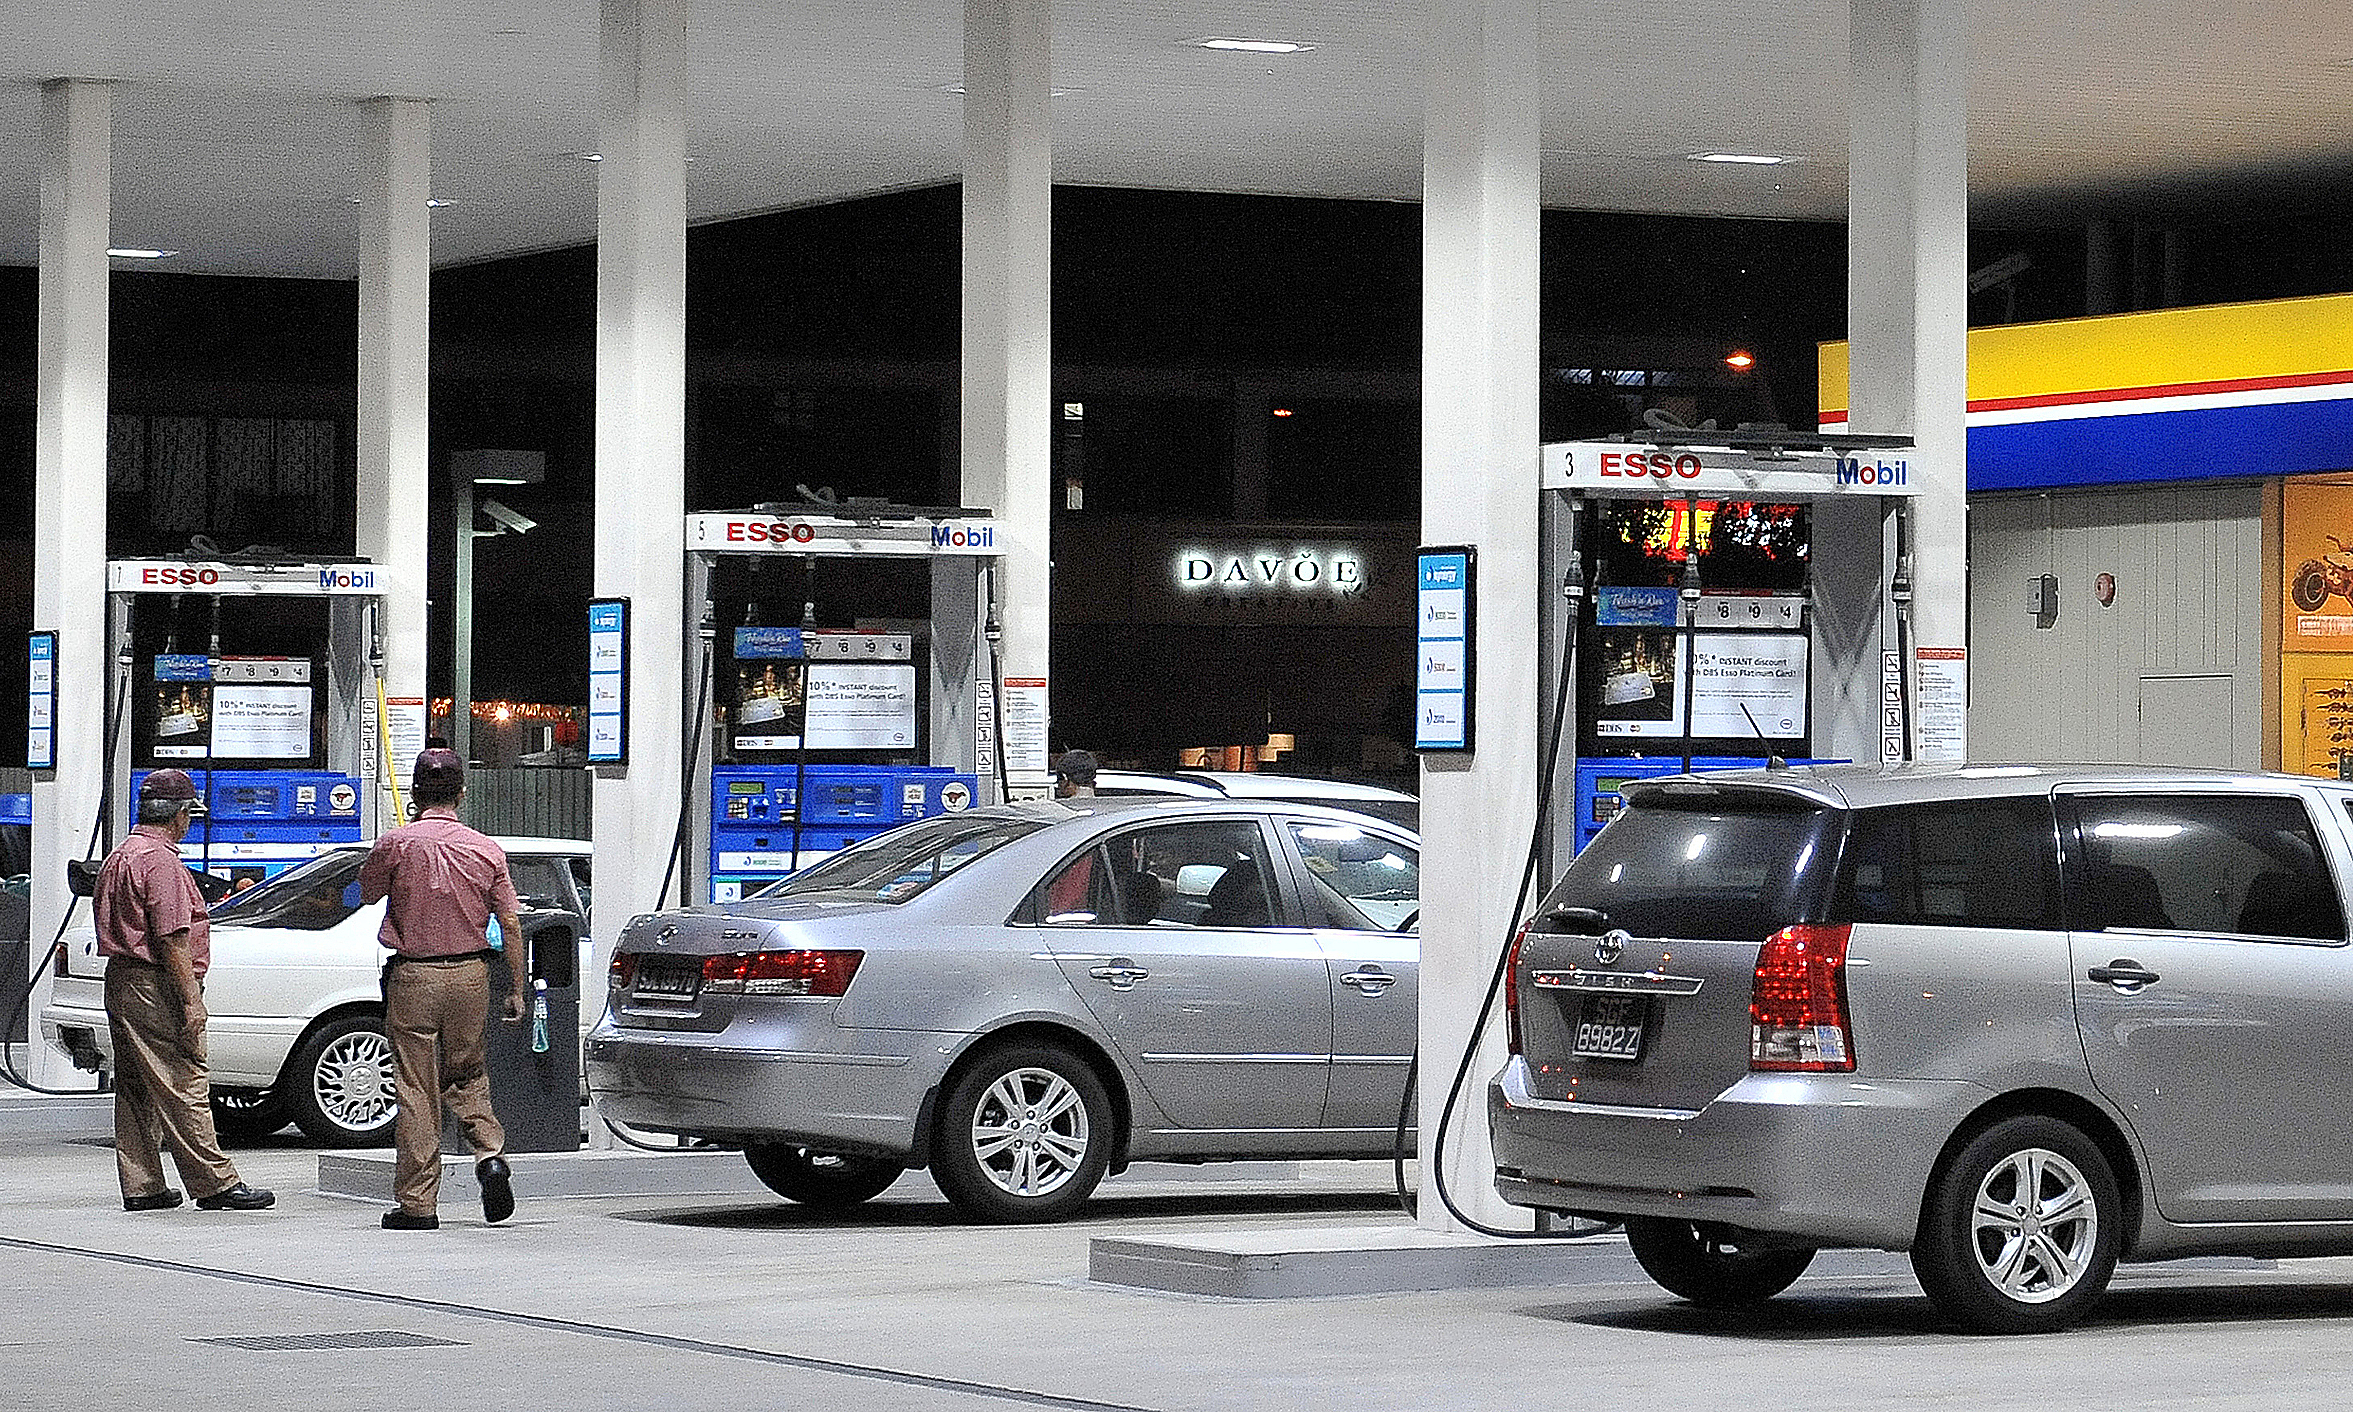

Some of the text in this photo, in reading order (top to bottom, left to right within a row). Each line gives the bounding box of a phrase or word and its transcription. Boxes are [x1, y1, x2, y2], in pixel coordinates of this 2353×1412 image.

[1565, 452, 1907, 486] 3 ESSO Mobil
[727, 523, 815, 543] ESSO
[931, 526, 993, 547] Mobil
[142, 568, 219, 585] ESSO
[319, 570, 374, 588] Mobil
[1721, 668, 1738, 677] Esso
[1754, 658, 1787, 666] discount
[1577, 1023, 1640, 1053] 8982Z
